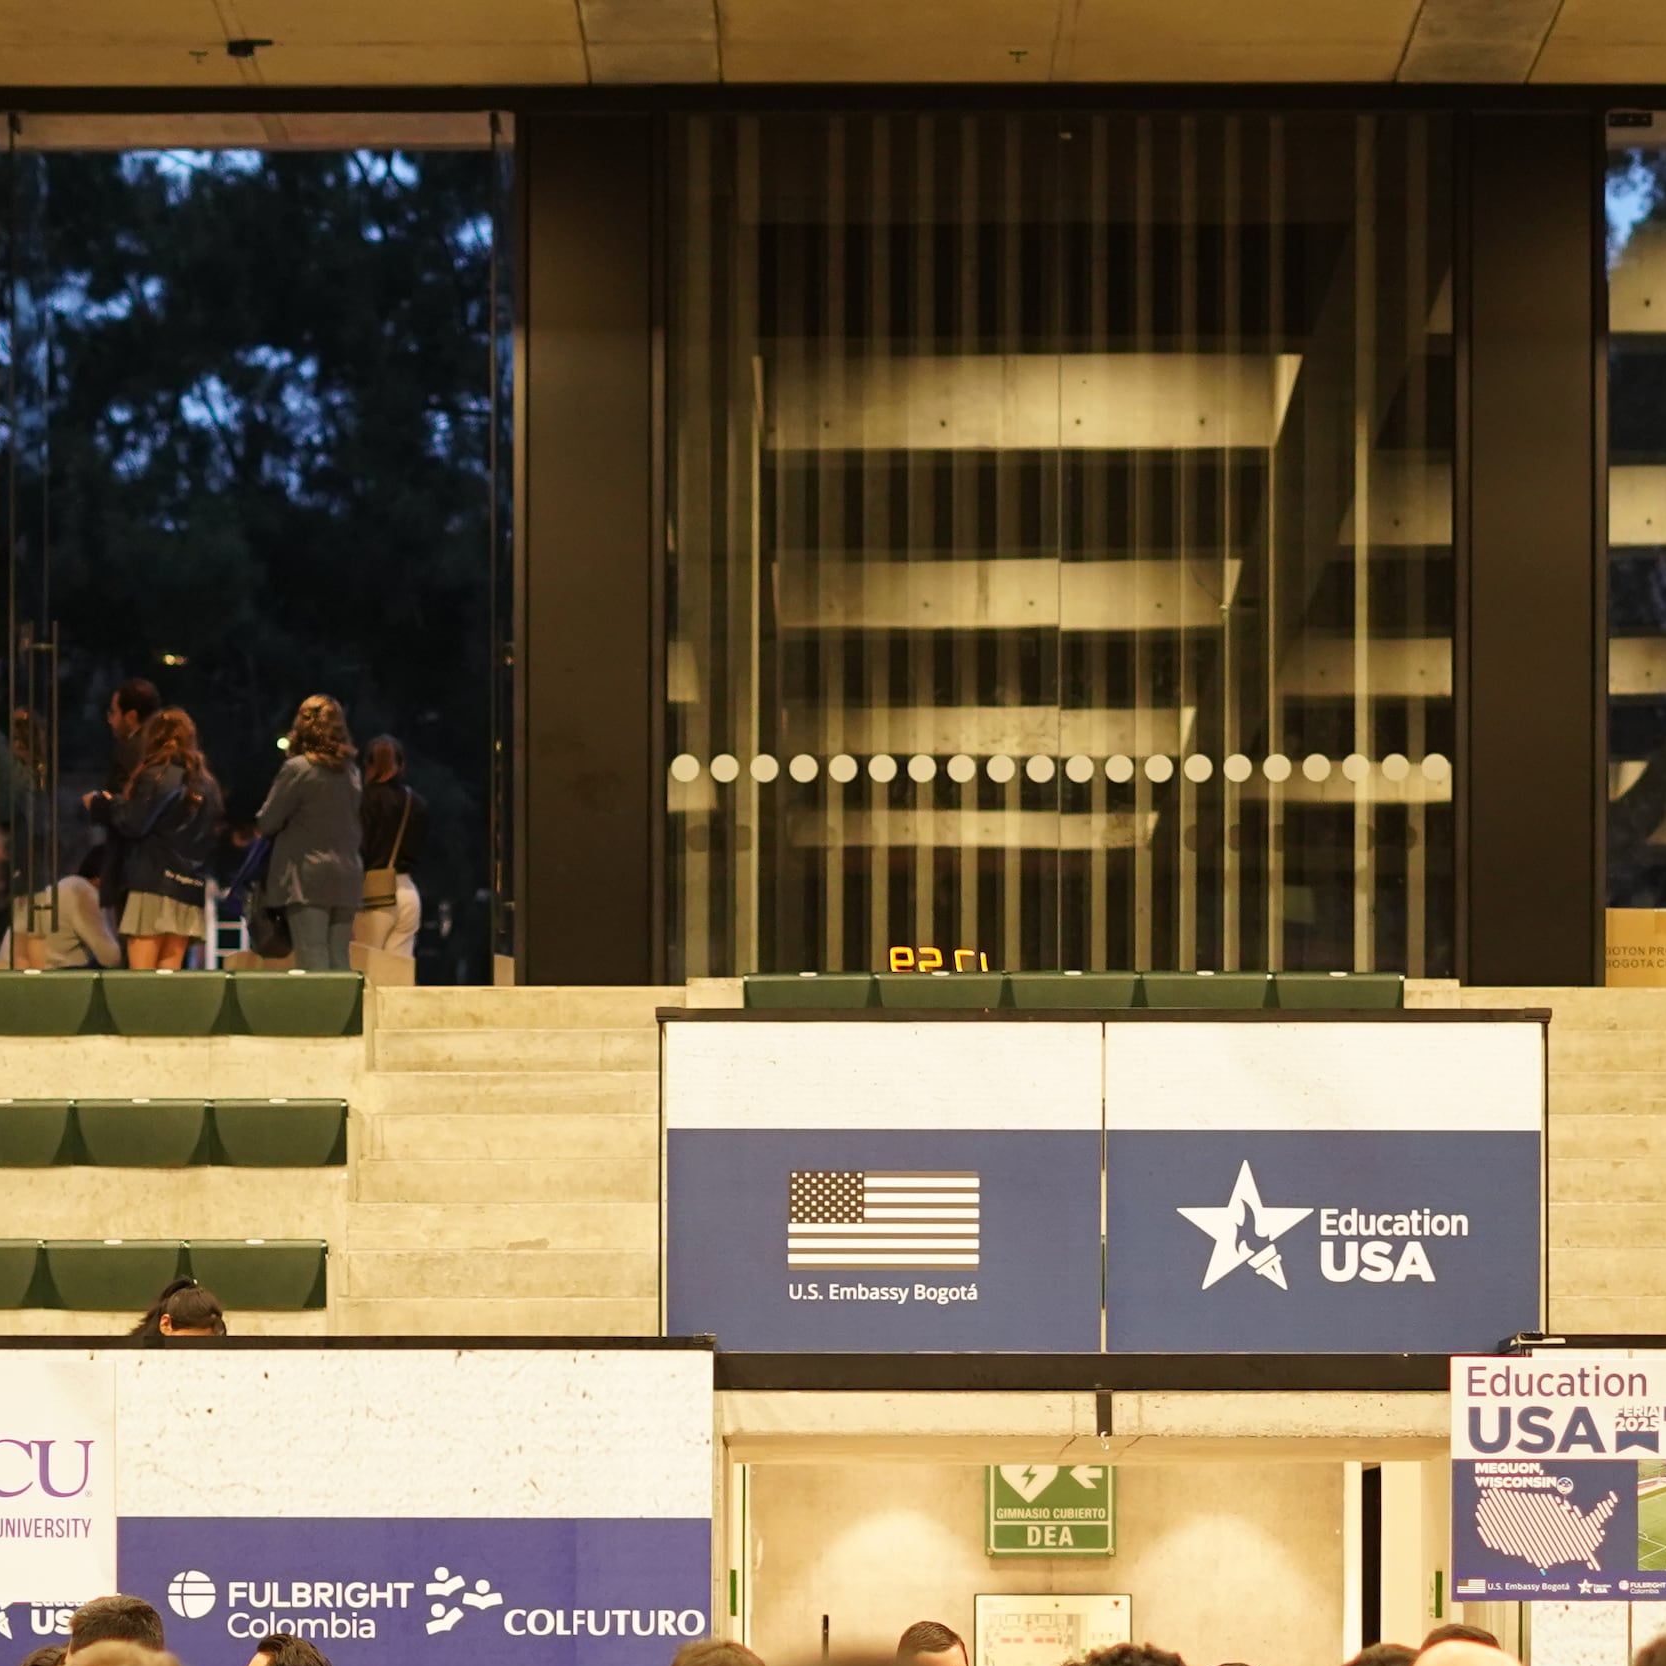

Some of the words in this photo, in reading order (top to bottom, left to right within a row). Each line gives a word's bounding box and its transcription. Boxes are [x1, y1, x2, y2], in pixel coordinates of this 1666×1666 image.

[1320, 1209, 1468, 1236] Education
[1320, 1241, 1436, 1282] USA
[789, 1283, 824, 1301] U.S.
[829, 1283, 908, 1305] Embassy
[914, 1282, 978, 1304] Bogotá
[1467, 1366, 1648, 1397] Education
[1615, 1406, 1659, 1418] FERIA
[1468, 1406, 1607, 1454] USA
[1615, 1417, 1660, 1432] 2025
[1475, 1462, 1544, 1476] MEQUON,
[1475, 1476, 1558, 1488] WISCONSIN
[997, 1508, 1050, 1519] GIMNASIO
[1053, 1507, 1106, 1519] CUBIERTO
[1027, 1526, 1074, 1546] DEA
[229, 1581, 414, 1608] FULBRIGHT
[1505, 1582, 1540, 1594] Embassy
[1541, 1581, 1570, 1594] Bogotá
[31, 1609, 75, 1635] US
[228, 1611, 376, 1639] Colombia
[504, 1608, 706, 1636] COLFUTURO
